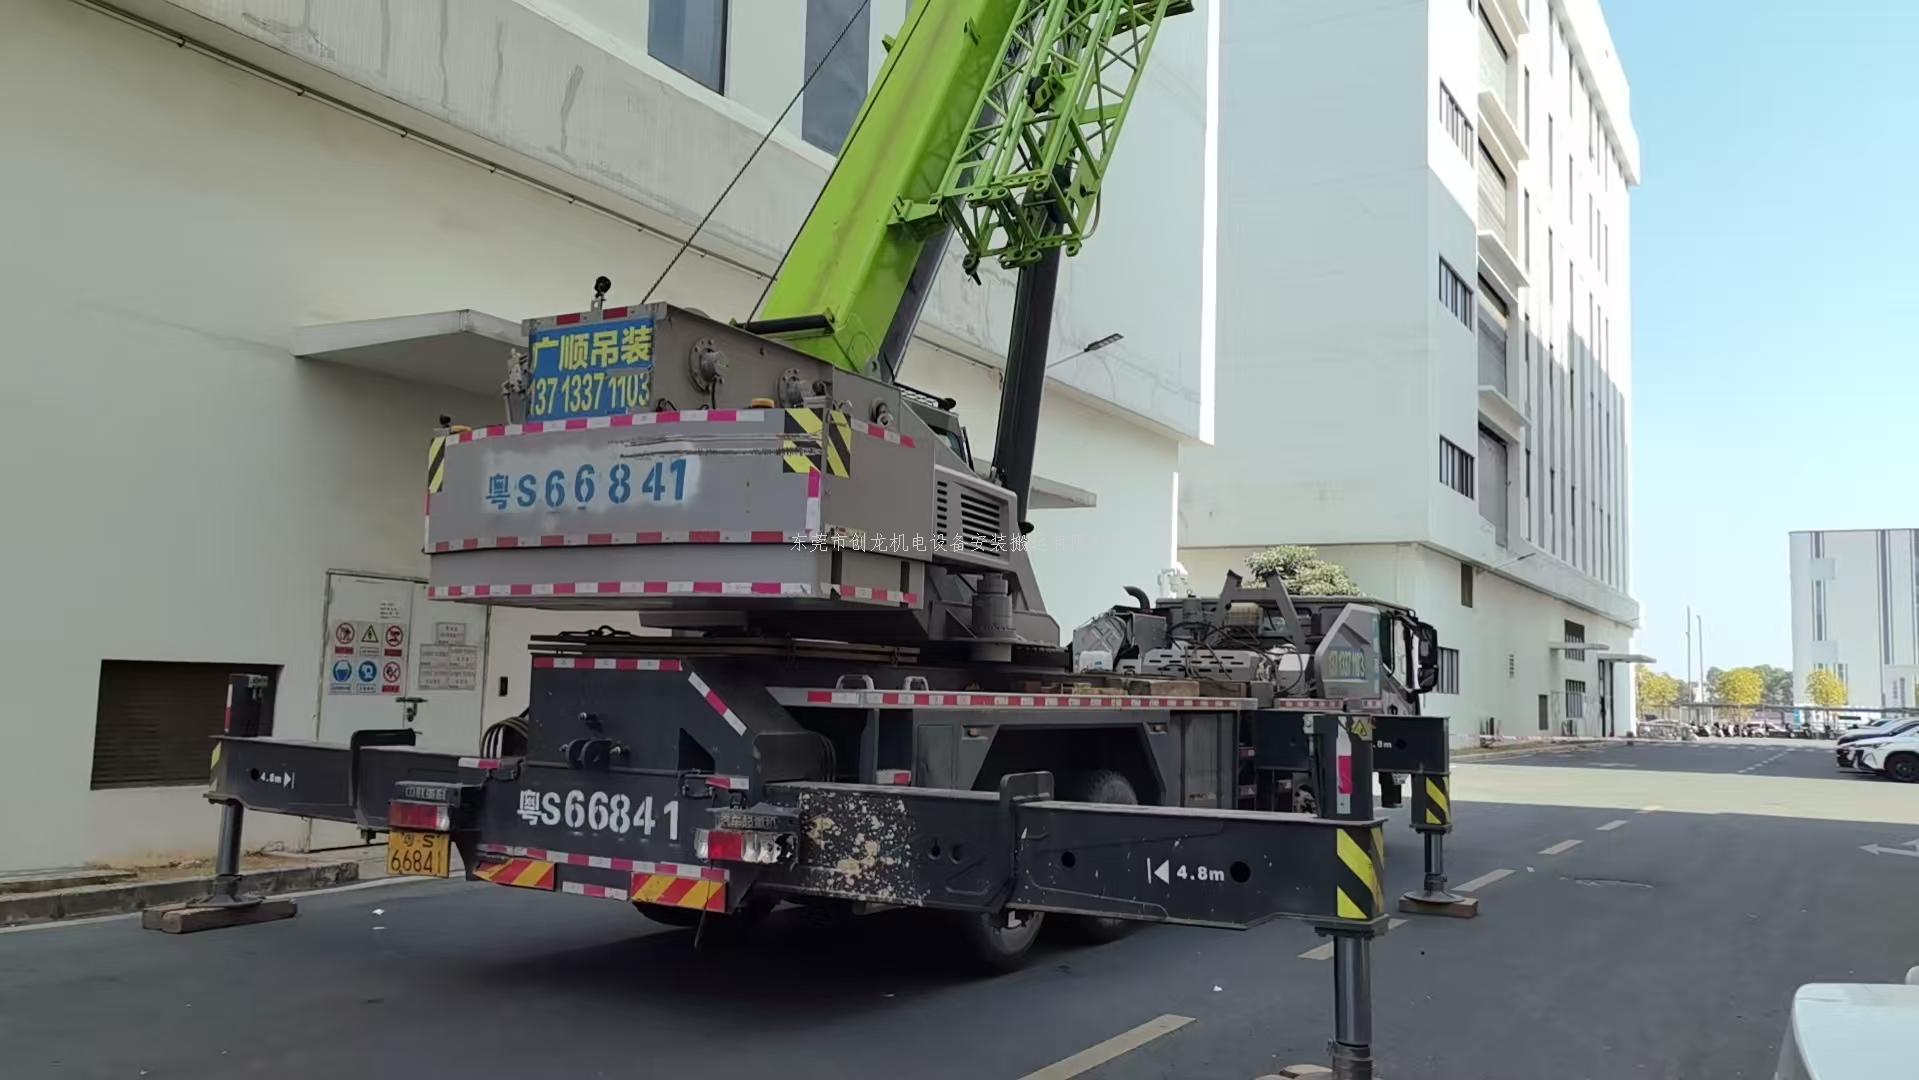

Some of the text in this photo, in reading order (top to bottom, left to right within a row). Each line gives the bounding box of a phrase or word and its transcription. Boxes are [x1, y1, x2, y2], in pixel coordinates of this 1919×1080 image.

[531, 325, 652, 373] 广顺吊装
[486, 458, 687, 510] 粤S66841
[518, 789, 679, 840] 粤S66841
[390, 849, 442, 875] 66841
[1176, 865, 1225, 881] 4.8m
